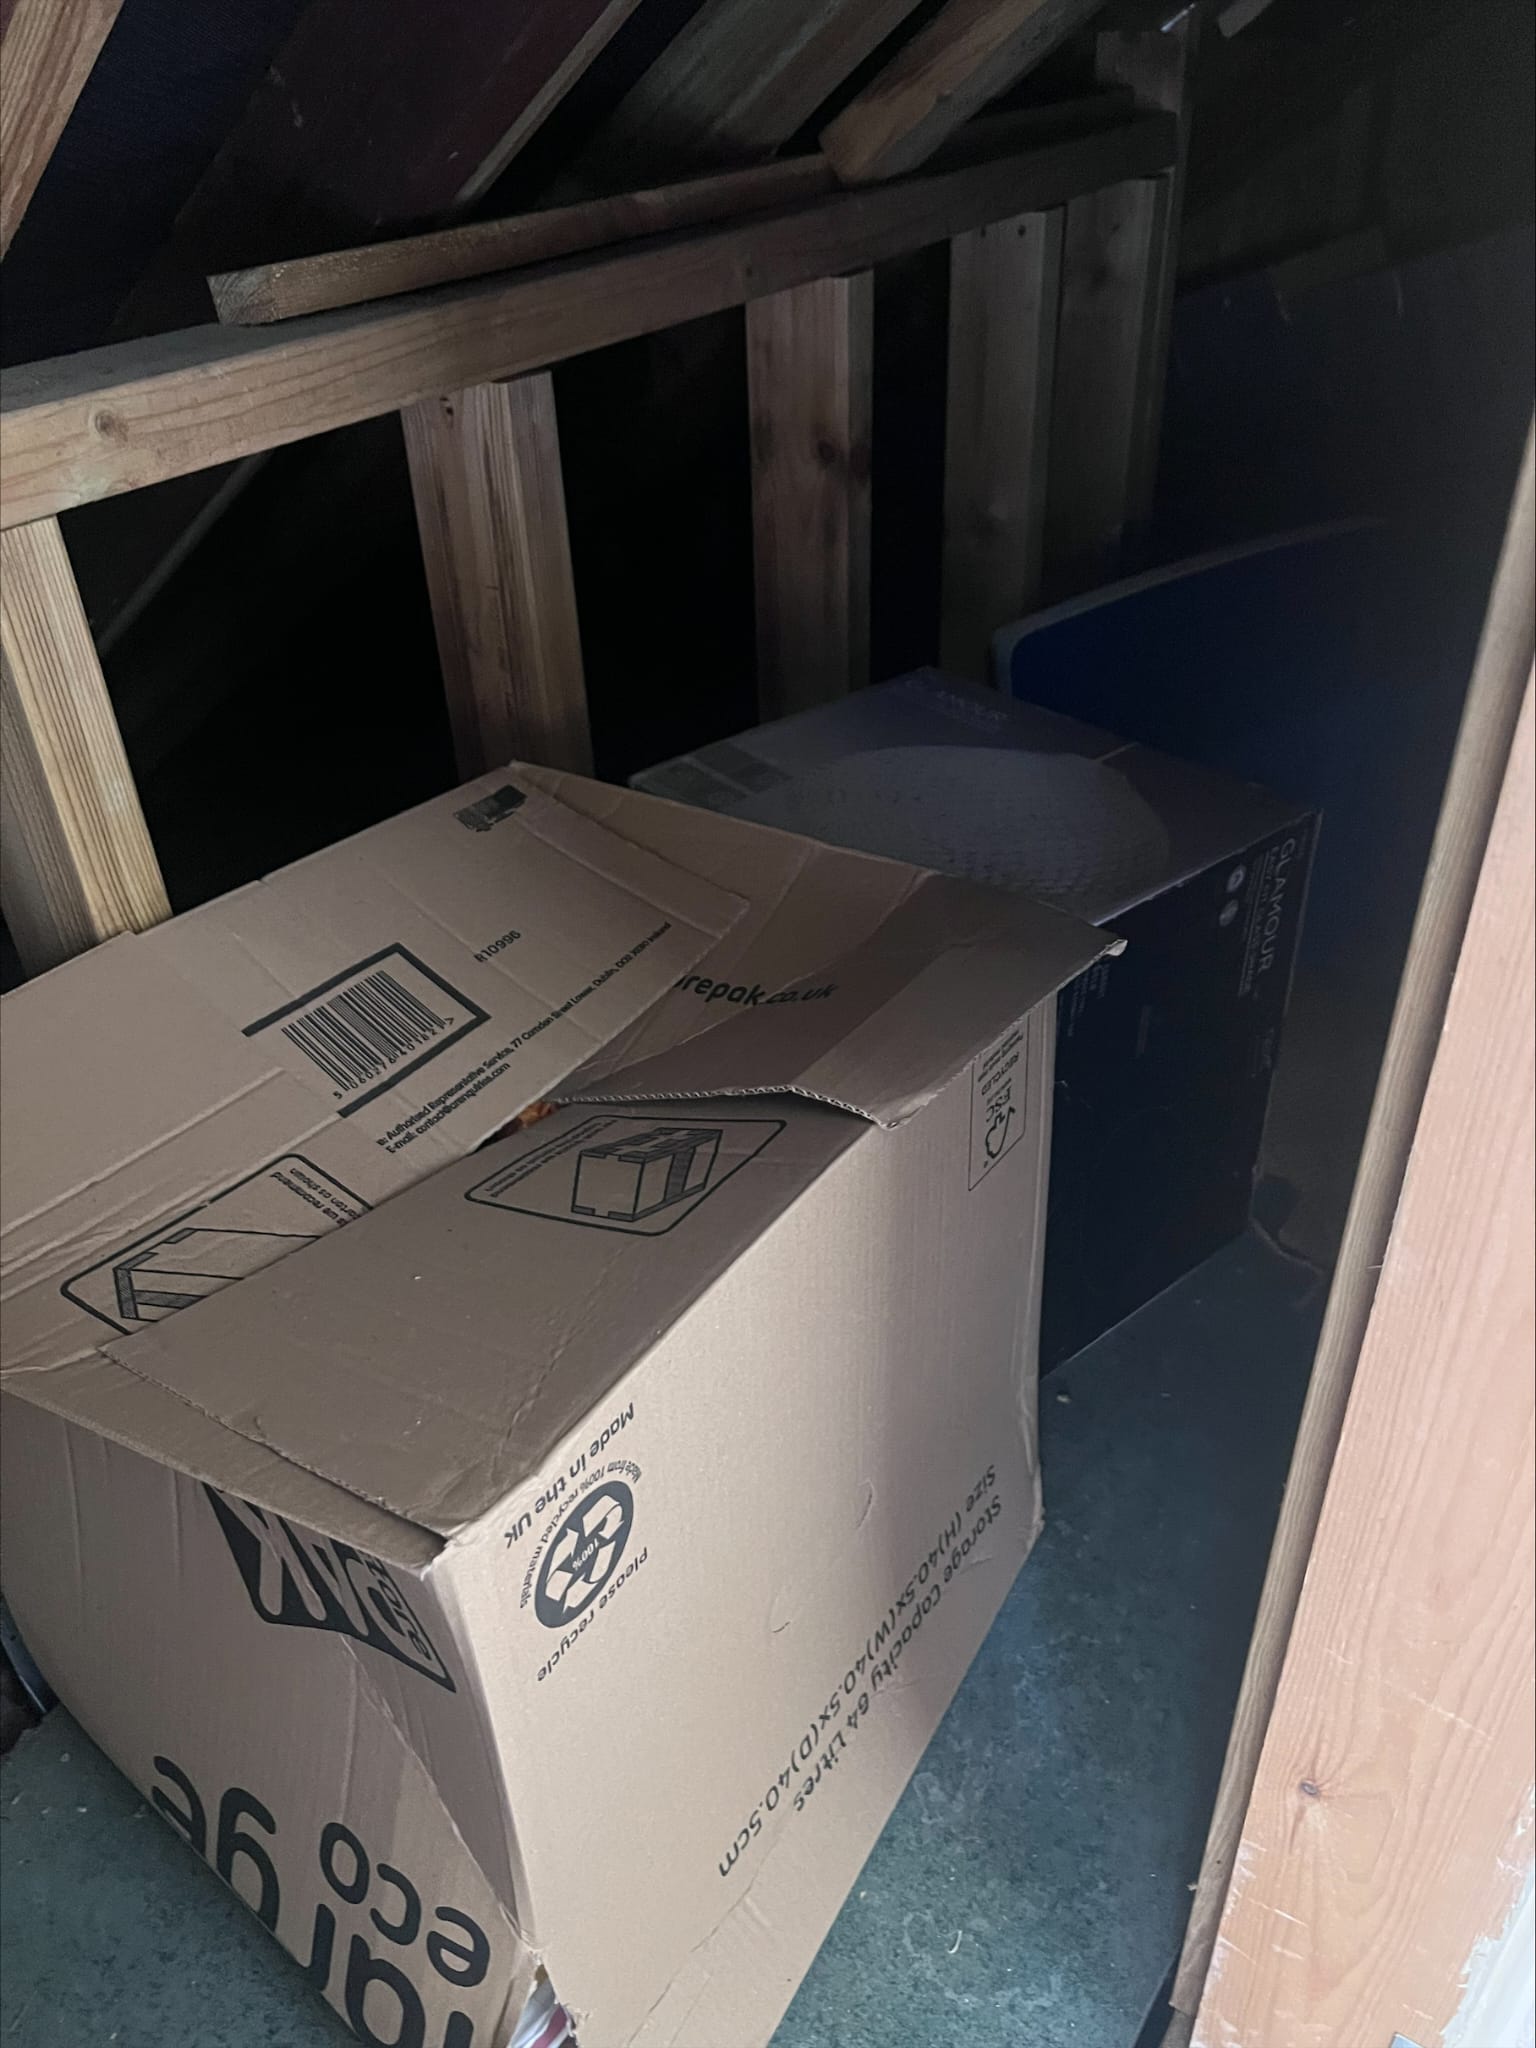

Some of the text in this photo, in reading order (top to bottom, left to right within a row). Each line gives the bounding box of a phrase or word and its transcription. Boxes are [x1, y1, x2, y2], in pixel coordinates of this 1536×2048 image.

[473, 930, 521, 963] R10996
[1256, 837, 1296, 973] GLAMOUR
[503, 1402, 635, 1549] Made in the UK
[540, 1487, 578, 1544] recycled
[966, 1464, 995, 1512] Size
[571, 1537, 600, 1571] 100%
[536, 1609, 594, 1682] recycle
[793, 1495, 1001, 1812] Storage Capacity 64 Litres
[152, 1755, 474, 2048] arge
[319, 1822, 490, 1987] eco
